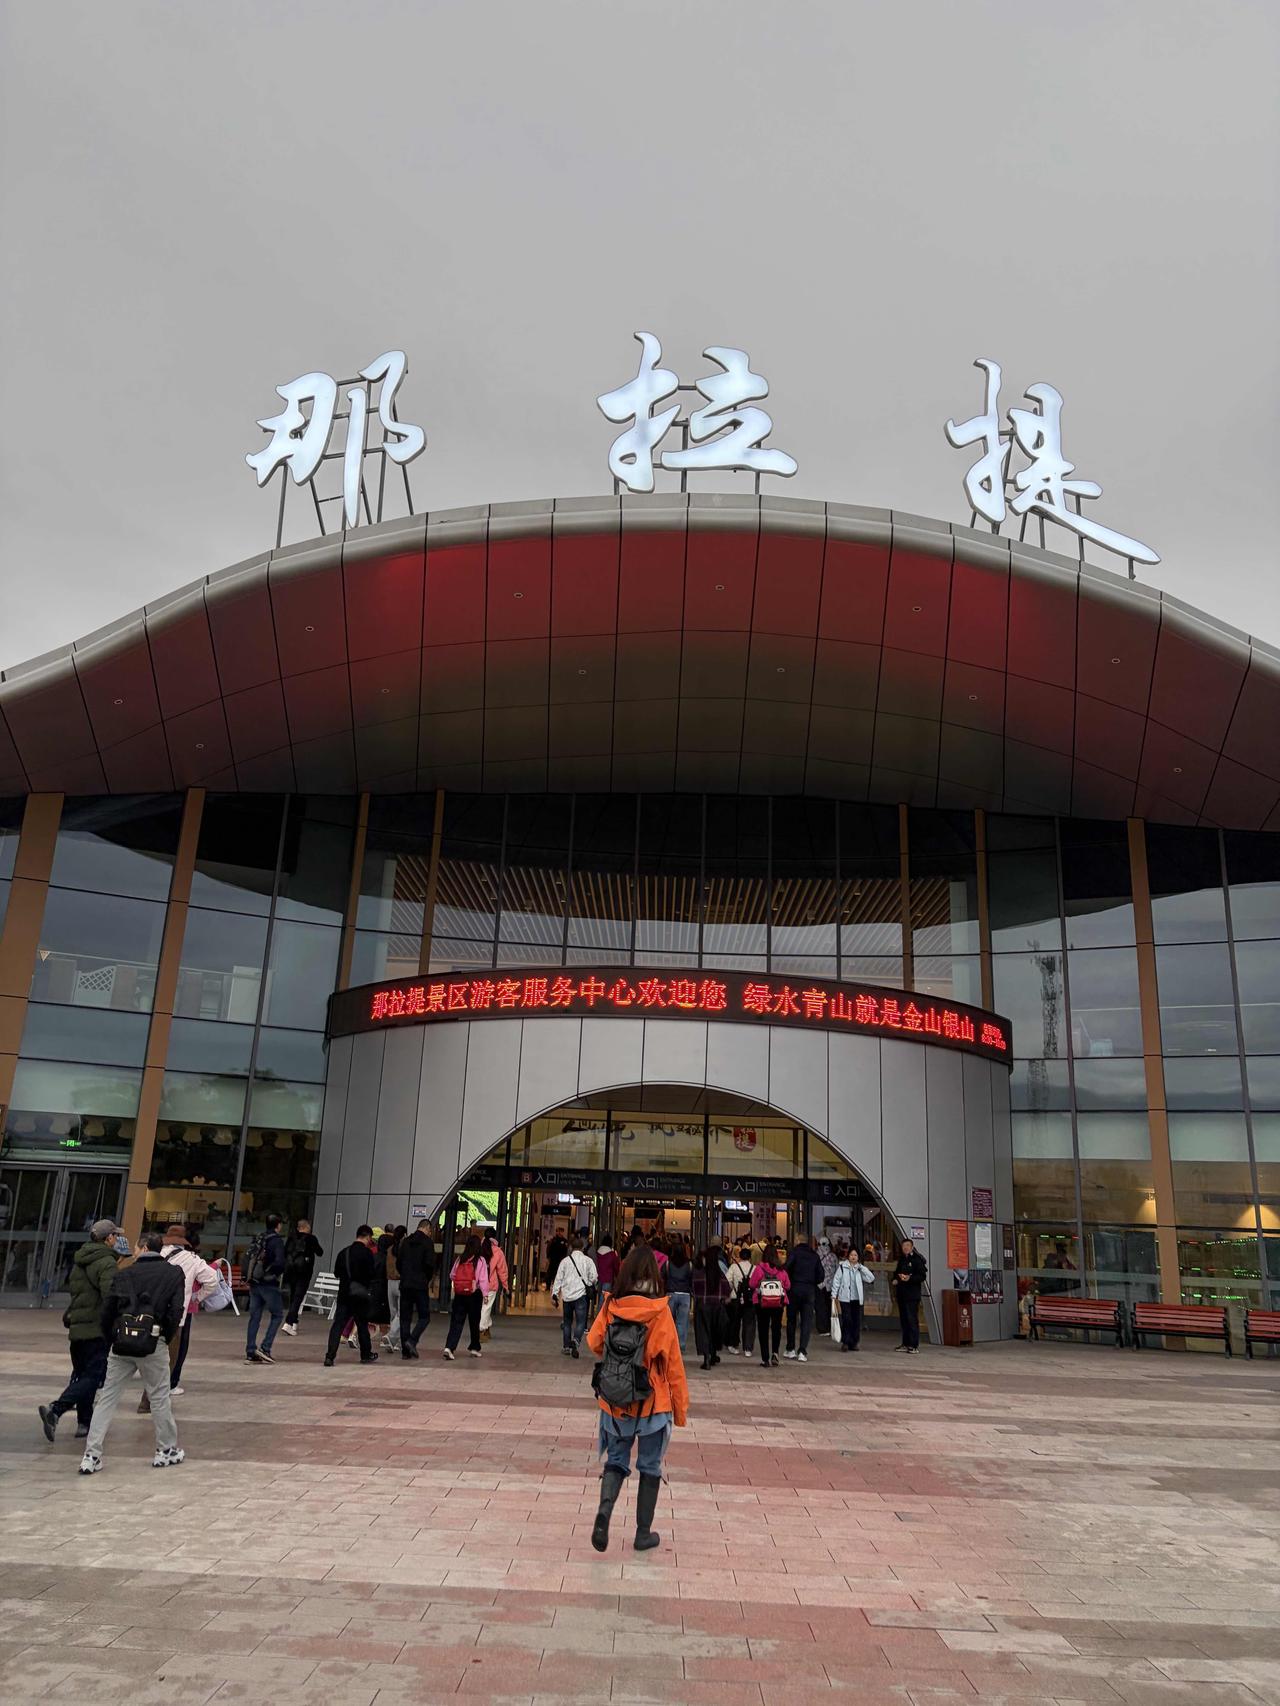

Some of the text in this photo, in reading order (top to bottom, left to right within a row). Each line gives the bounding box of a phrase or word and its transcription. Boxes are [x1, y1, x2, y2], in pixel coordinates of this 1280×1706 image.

[246, 331, 1160, 565] 那拉提
[370, 976, 975, 1043] 那拉提景区游客服务中心欢迎您 绿水青山就是金山银山
[534, 1172, 557, 1184] 入口
[634, 1177, 656, 1189] 入口
[722, 1181, 729, 1190] D
[733, 1180, 756, 1192] 入口
[823, 1185, 857, 1197] E 入口
